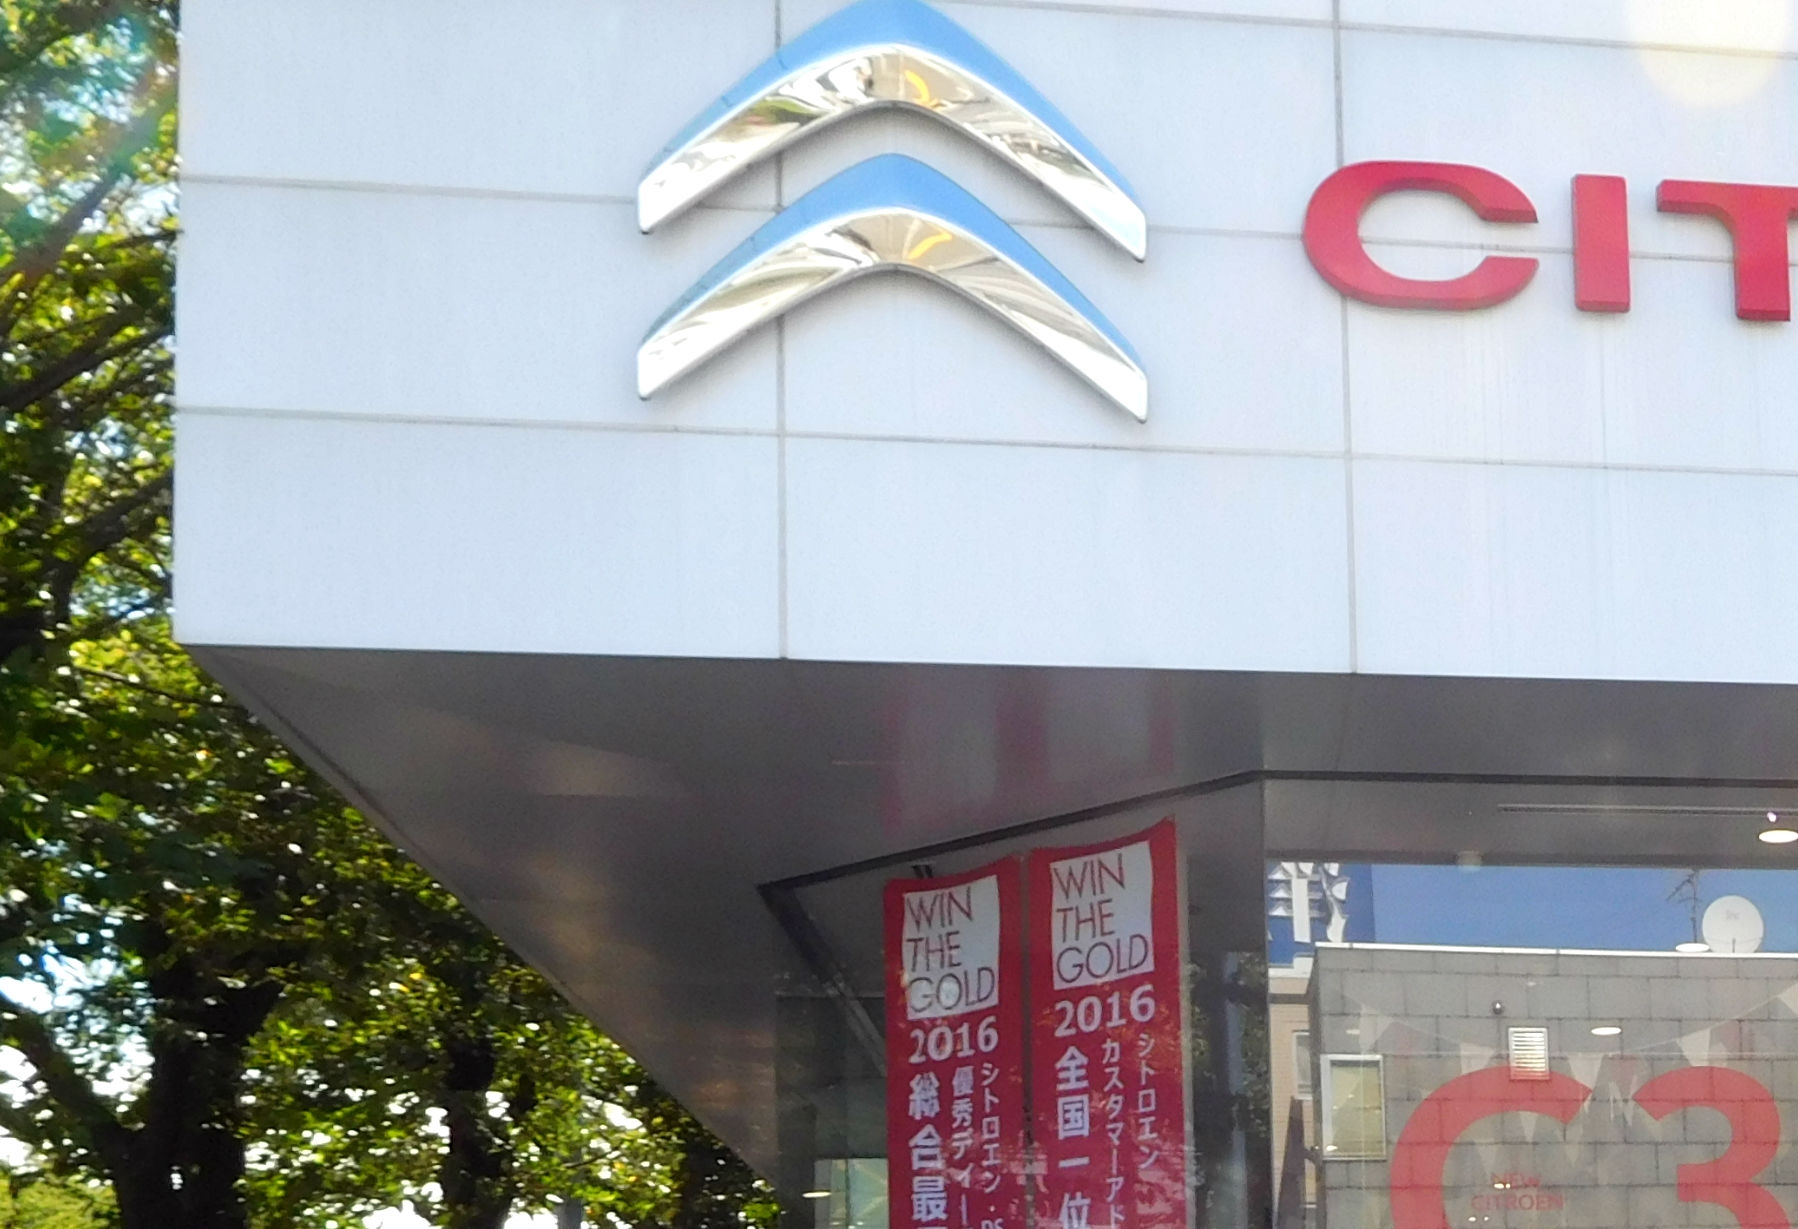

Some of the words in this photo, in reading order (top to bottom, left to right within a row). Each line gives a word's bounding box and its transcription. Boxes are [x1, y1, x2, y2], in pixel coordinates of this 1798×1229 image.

[1054, 853, 1125, 899] WIN
[908, 887, 973, 931] WIN
[1056, 900, 1115, 942] THE
[907, 934, 961, 972] THE
[1056, 935, 1149, 984] GOLD
[908, 967, 995, 1013] GOLD
[1055, 984, 1155, 1038] 2016
[908, 1016, 998, 1064] 2016
[1137, 1034, 1158, 1170] シトロエン
